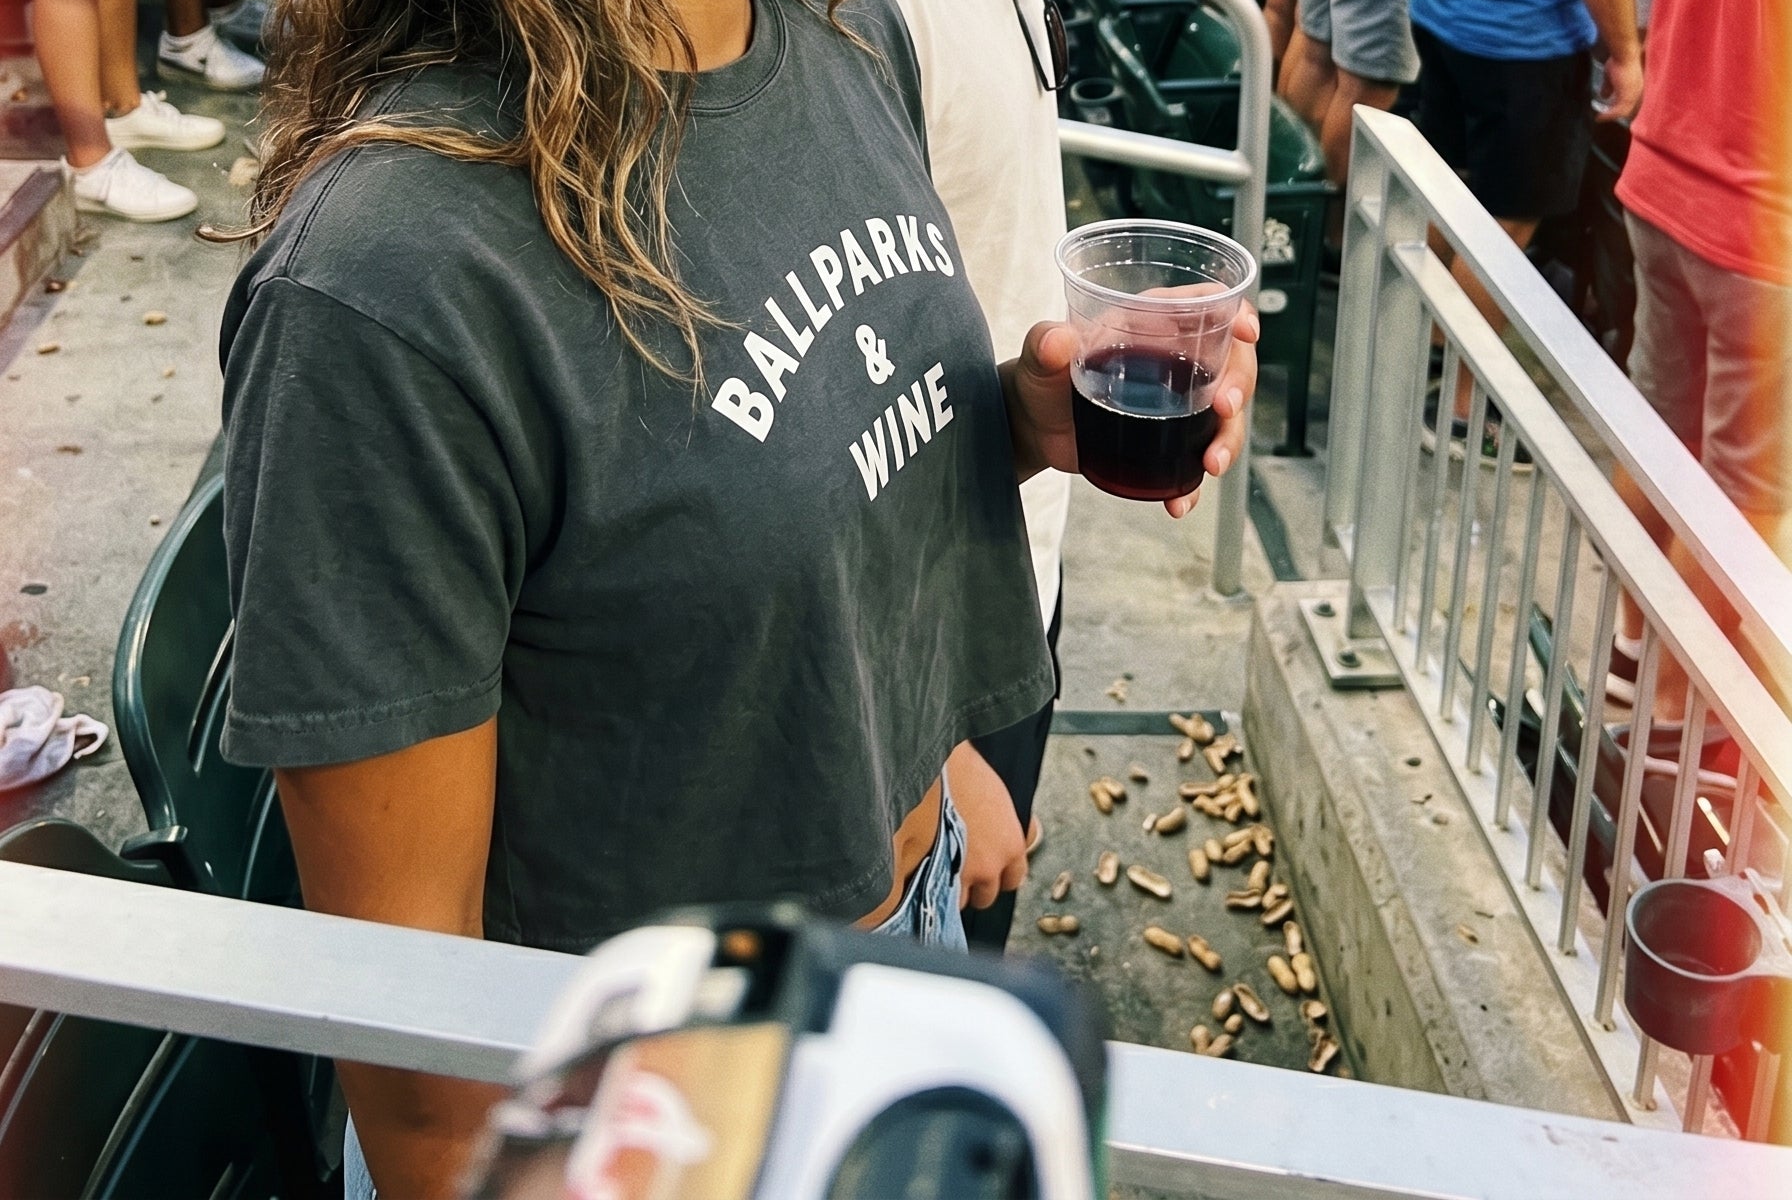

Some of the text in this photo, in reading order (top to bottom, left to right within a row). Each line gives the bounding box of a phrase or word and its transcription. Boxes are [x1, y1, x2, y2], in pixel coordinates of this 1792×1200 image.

[711, 215, 954, 443] BALLPARKS
[855, 324, 896, 385] &
[849, 362, 954, 502] WINE
